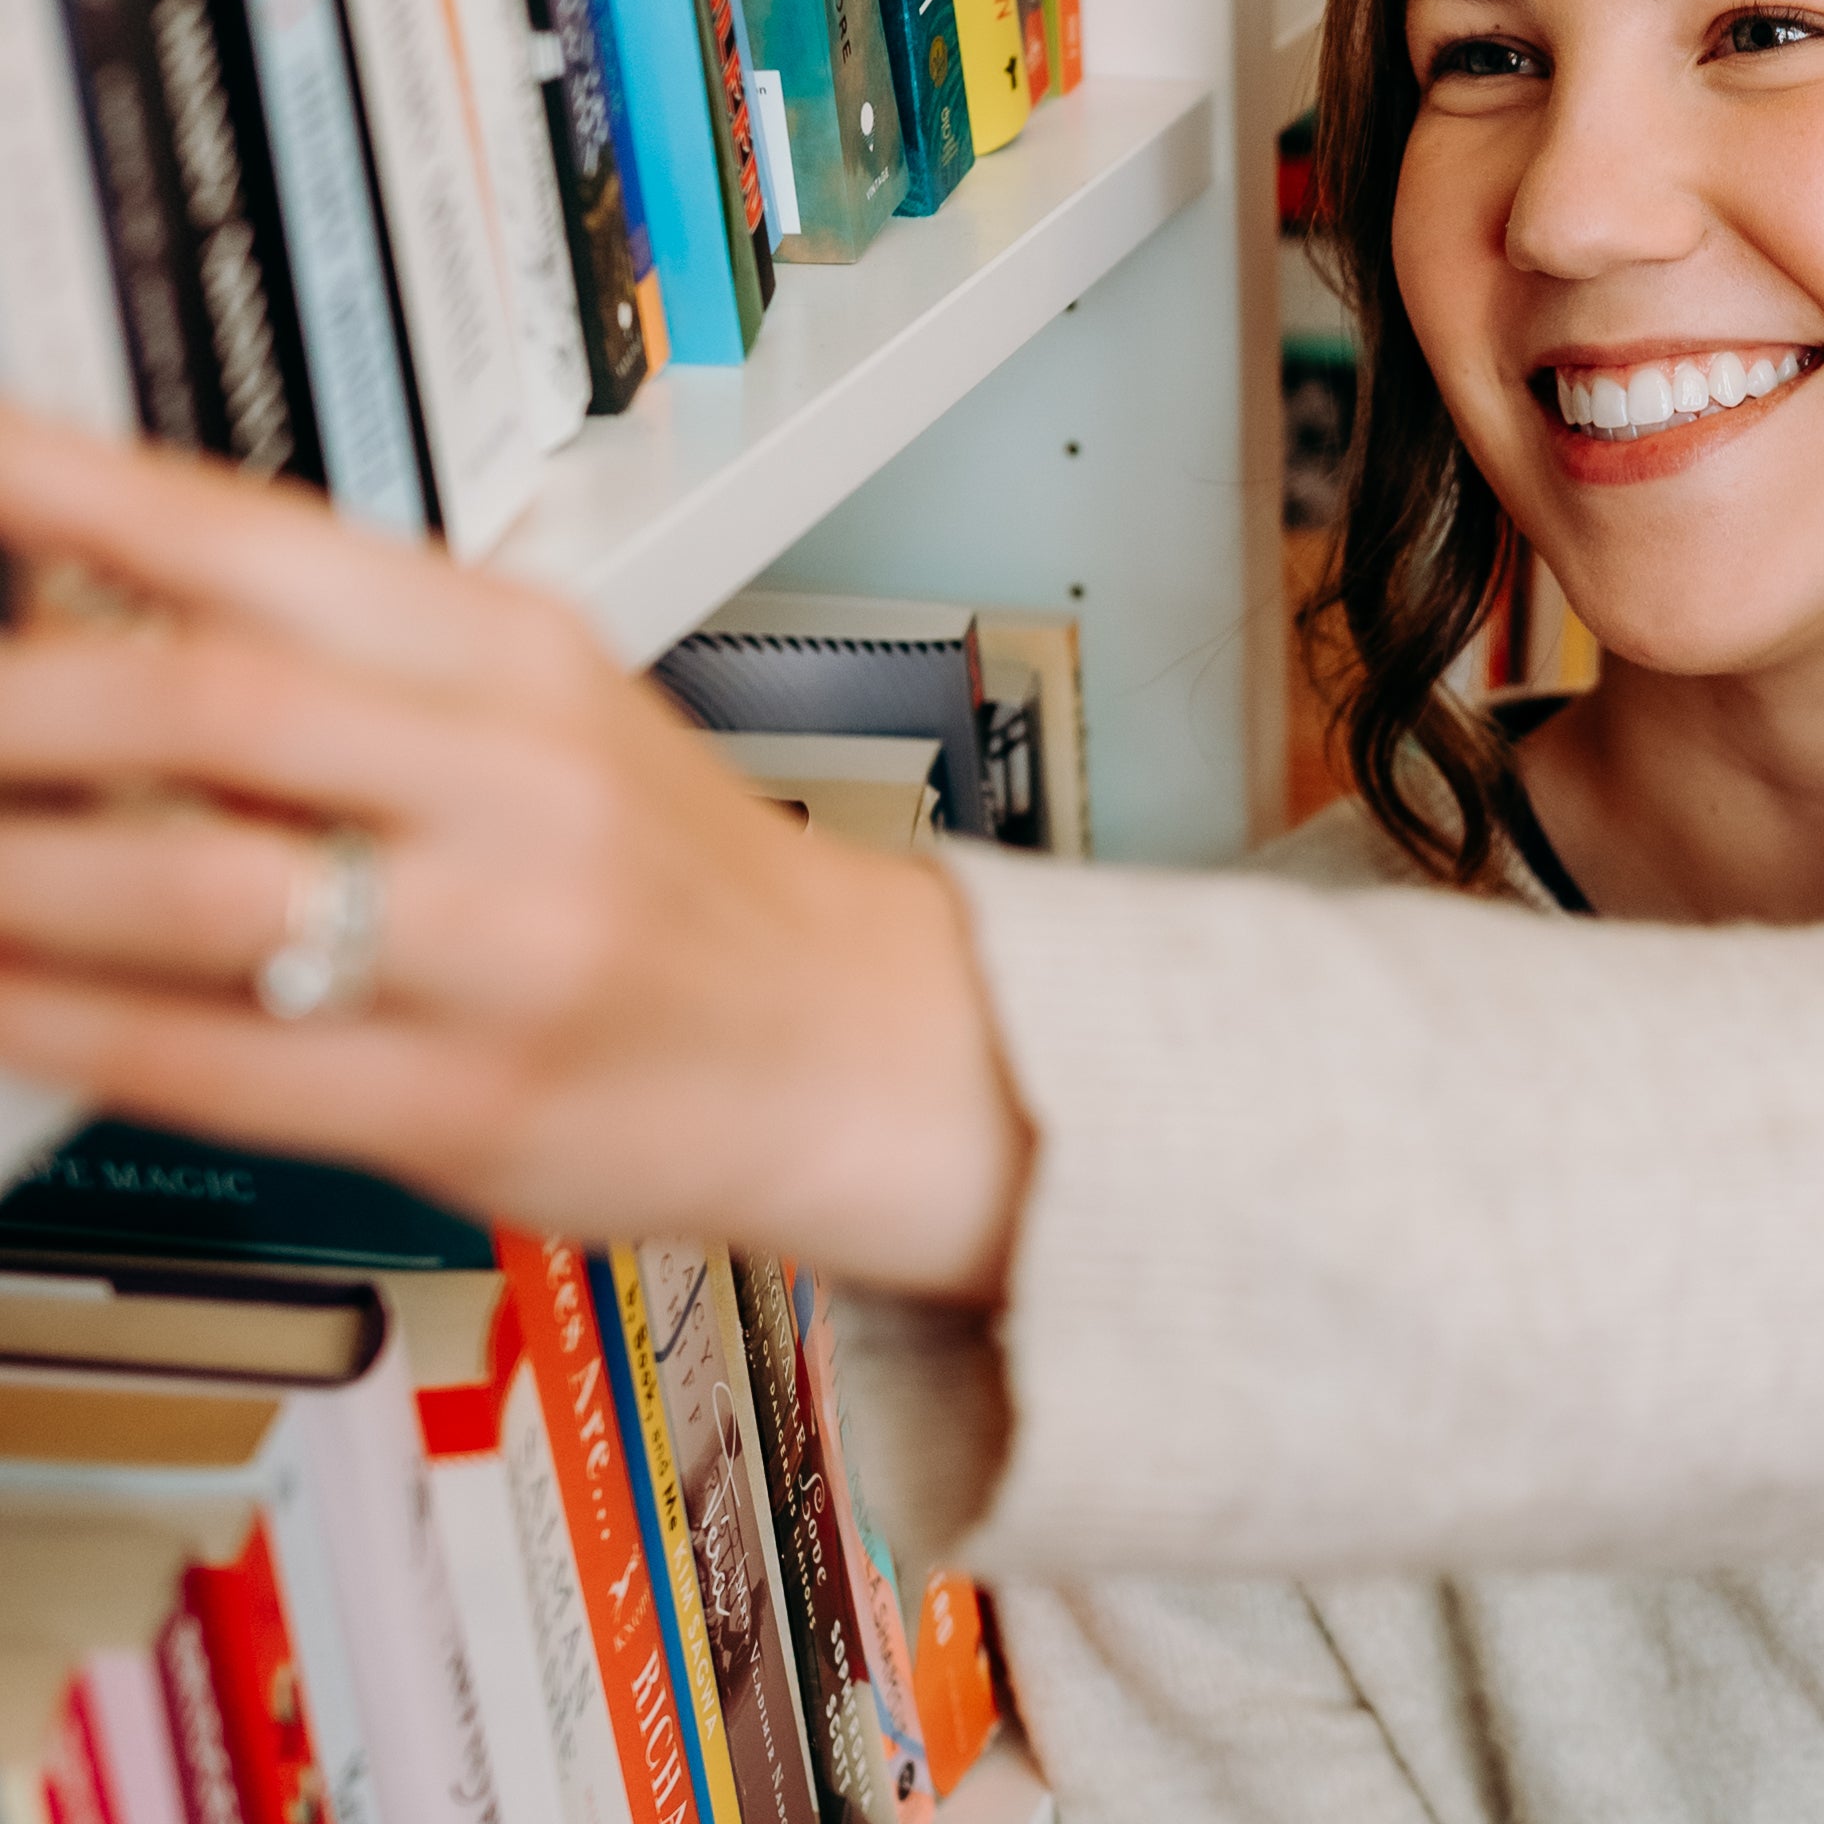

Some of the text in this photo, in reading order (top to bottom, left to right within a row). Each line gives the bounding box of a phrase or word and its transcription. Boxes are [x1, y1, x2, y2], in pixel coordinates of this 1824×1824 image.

[659, 1251, 701, 1424] CHIFF
[570, 1357, 612, 1543] Are...
[762, 1338, 772, 1369] OF
[767, 1379, 798, 1519] DANGEROUS
[793, 1525, 818, 1632] LIAISONS
[672, 1538, 718, 1742] KIM SAGWA
[825, 1691, 853, 1796] SCOTT
